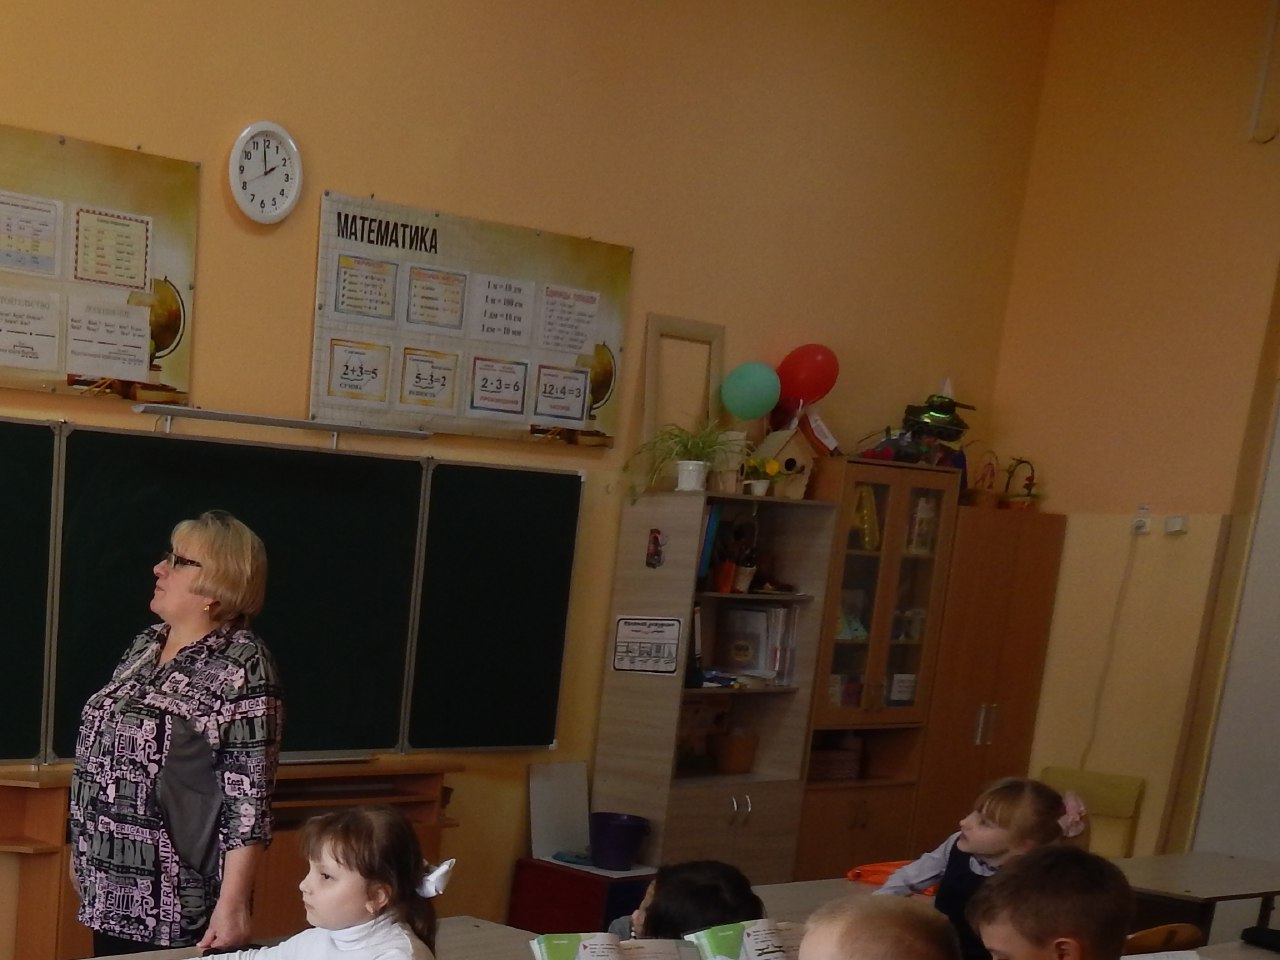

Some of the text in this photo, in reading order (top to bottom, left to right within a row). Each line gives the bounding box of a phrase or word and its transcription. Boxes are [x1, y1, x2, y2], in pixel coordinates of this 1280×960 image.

[253, 141, 259, 151] 11
[275, 145, 279, 154] 1
[244, 151, 252, 160] 10
[282, 158, 287, 167] 2
[239, 165, 244, 174] 9
[285, 173, 289, 182] 3
[242, 181, 247, 191] 8
[250, 194, 255, 202] 7
[272, 197, 277, 206] 5
[260, 200, 266, 209] 6
[337, 212, 438, 254] МАТЕМАТИКА
[343, 364, 378, 380] 2+3=5
